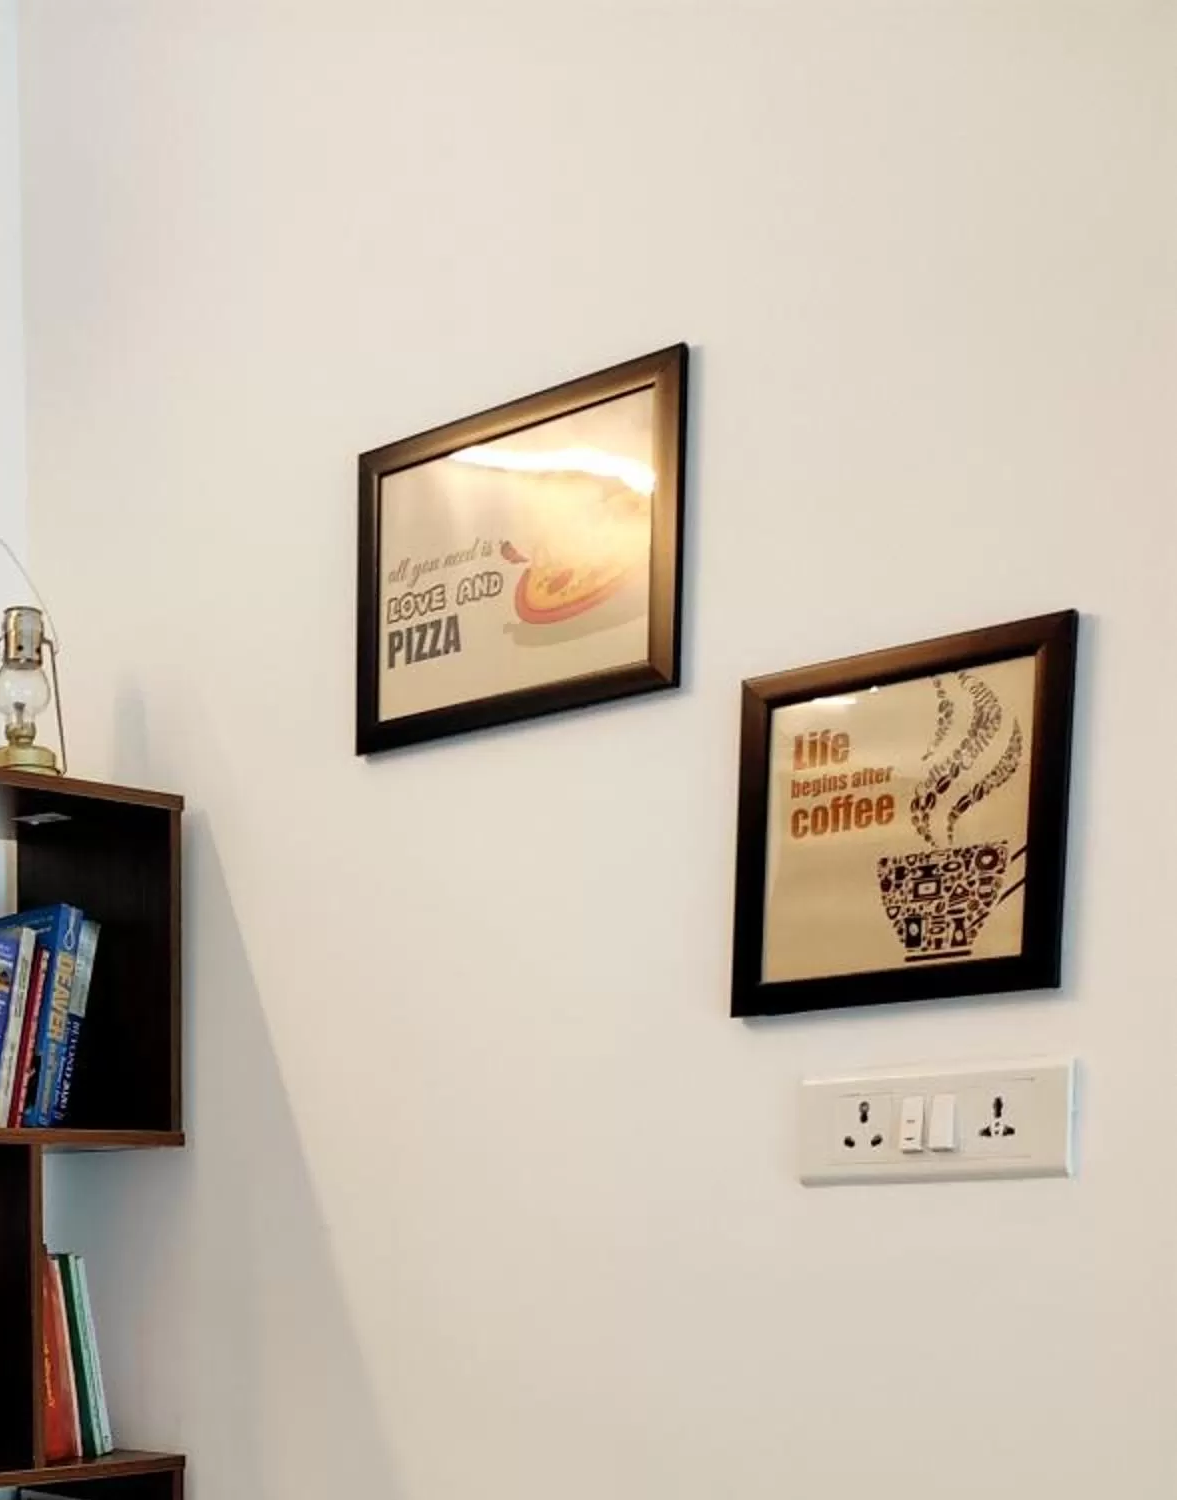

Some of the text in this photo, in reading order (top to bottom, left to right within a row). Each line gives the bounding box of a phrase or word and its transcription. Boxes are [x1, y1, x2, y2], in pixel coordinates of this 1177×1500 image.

[387, 571, 504, 624] LOVE AND
[387, 613, 462, 670] PIZZA
[792, 729, 850, 772] Life
[790, 766, 895, 799] begins after
[790, 793, 895, 840] coffee
